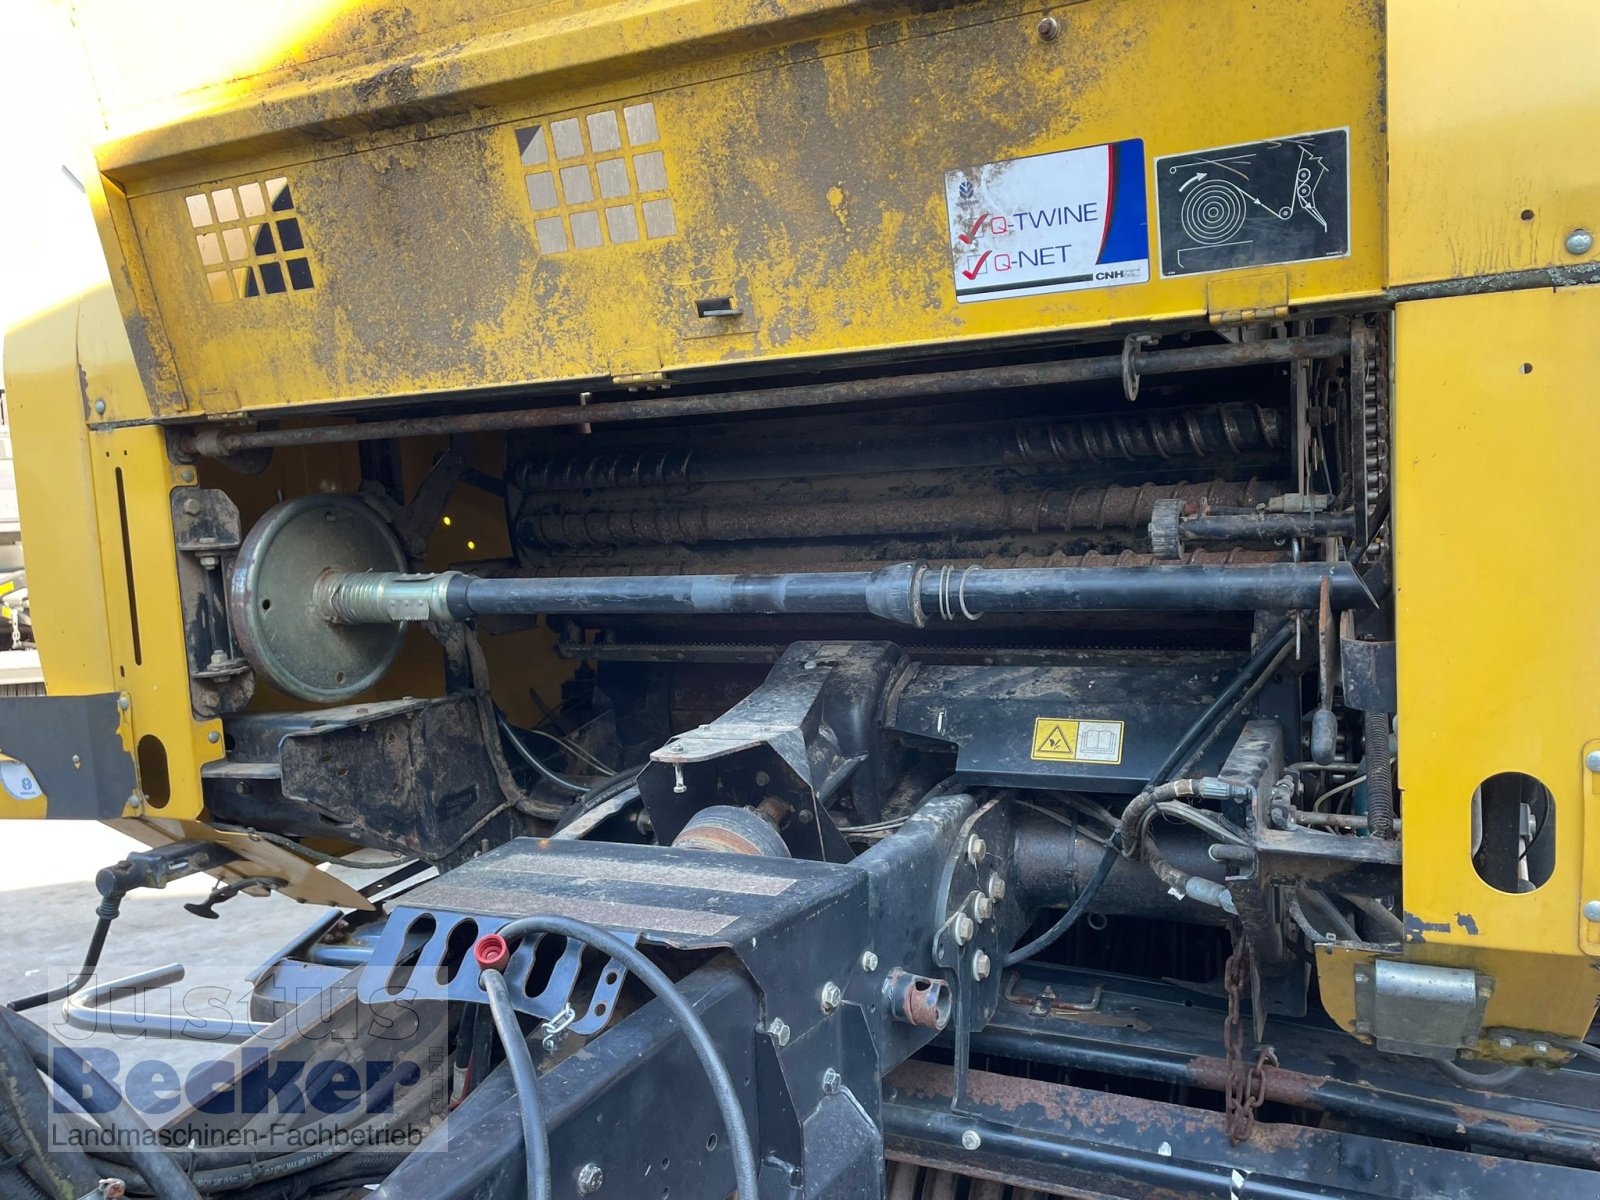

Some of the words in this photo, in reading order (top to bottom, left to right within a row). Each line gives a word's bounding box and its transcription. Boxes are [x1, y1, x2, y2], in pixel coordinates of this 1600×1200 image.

[989, 202, 1099, 236] Q-TWINE
[994, 244, 1073, 272] Q-NET
[1095, 270, 1124, 281] CNH
